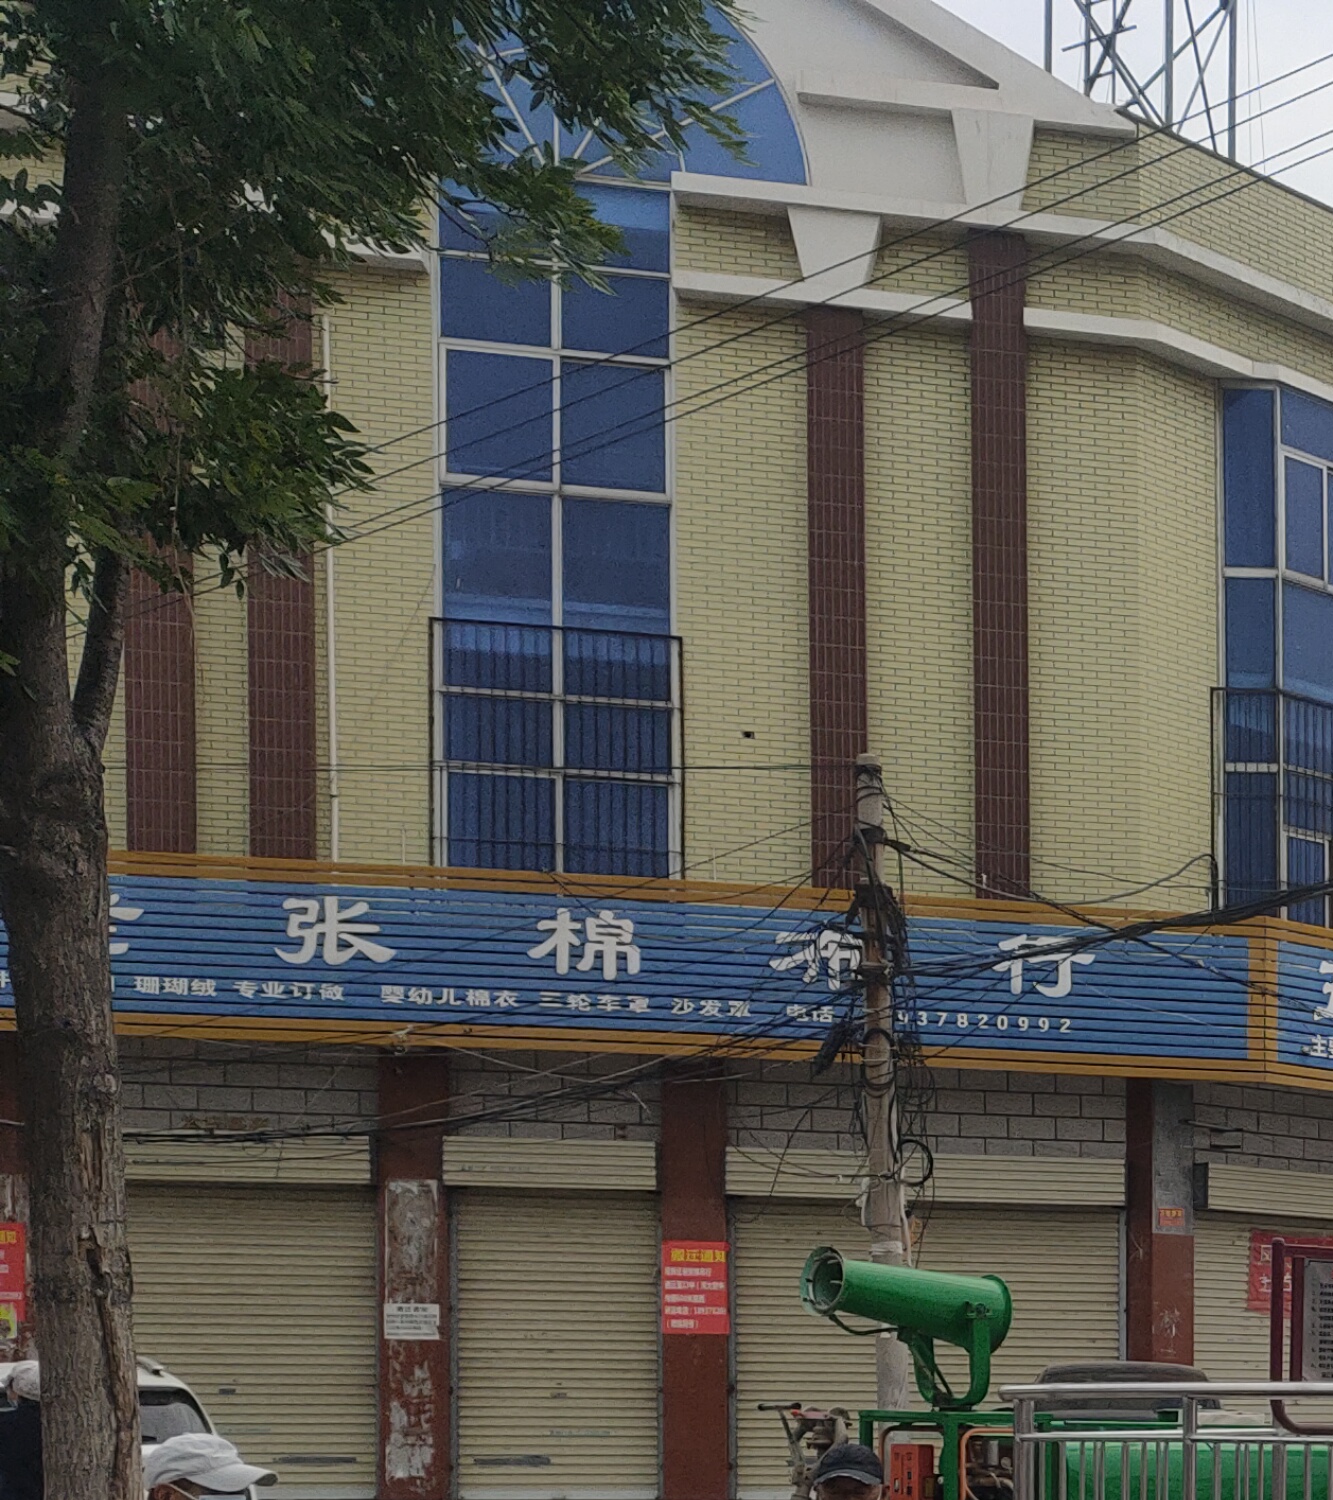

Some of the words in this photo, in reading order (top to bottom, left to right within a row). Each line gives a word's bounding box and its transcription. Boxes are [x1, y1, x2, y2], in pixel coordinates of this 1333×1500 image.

[134, 976, 217, 997] 珊瑚绒
[380, 986, 519, 1007] 婴幼儿棉衣
[539, 991, 651, 1014] 三轮车罩
[786, 1004, 835, 1023] 电话
